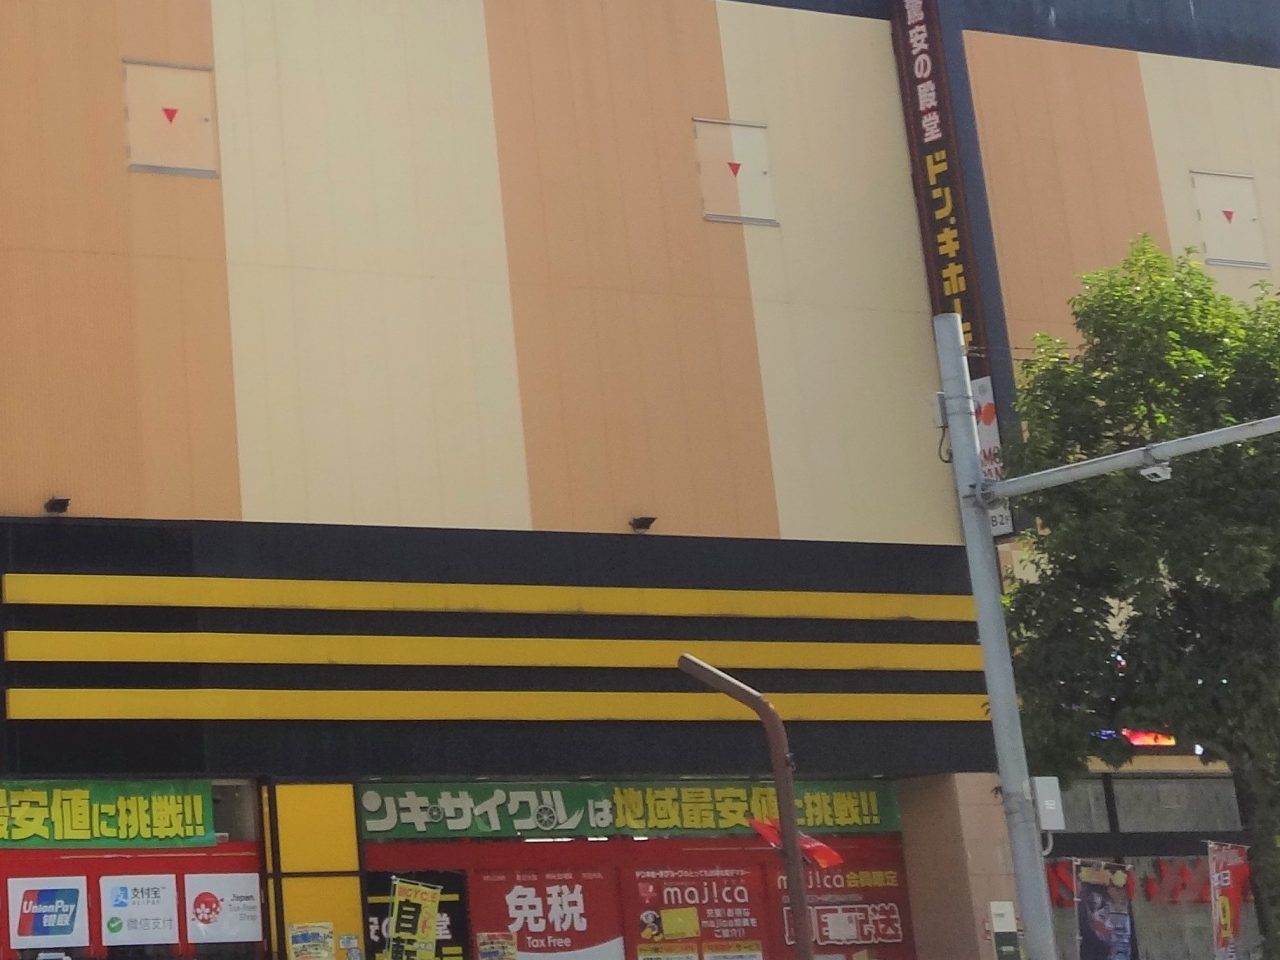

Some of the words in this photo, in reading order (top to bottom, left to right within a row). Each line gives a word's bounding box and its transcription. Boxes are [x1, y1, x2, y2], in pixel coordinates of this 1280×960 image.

[22, 900, 76, 920] UnionPay
[505, 884, 587, 932] 免税
[527, 937, 546, 948] Tax
[548, 936, 572, 947] Free
